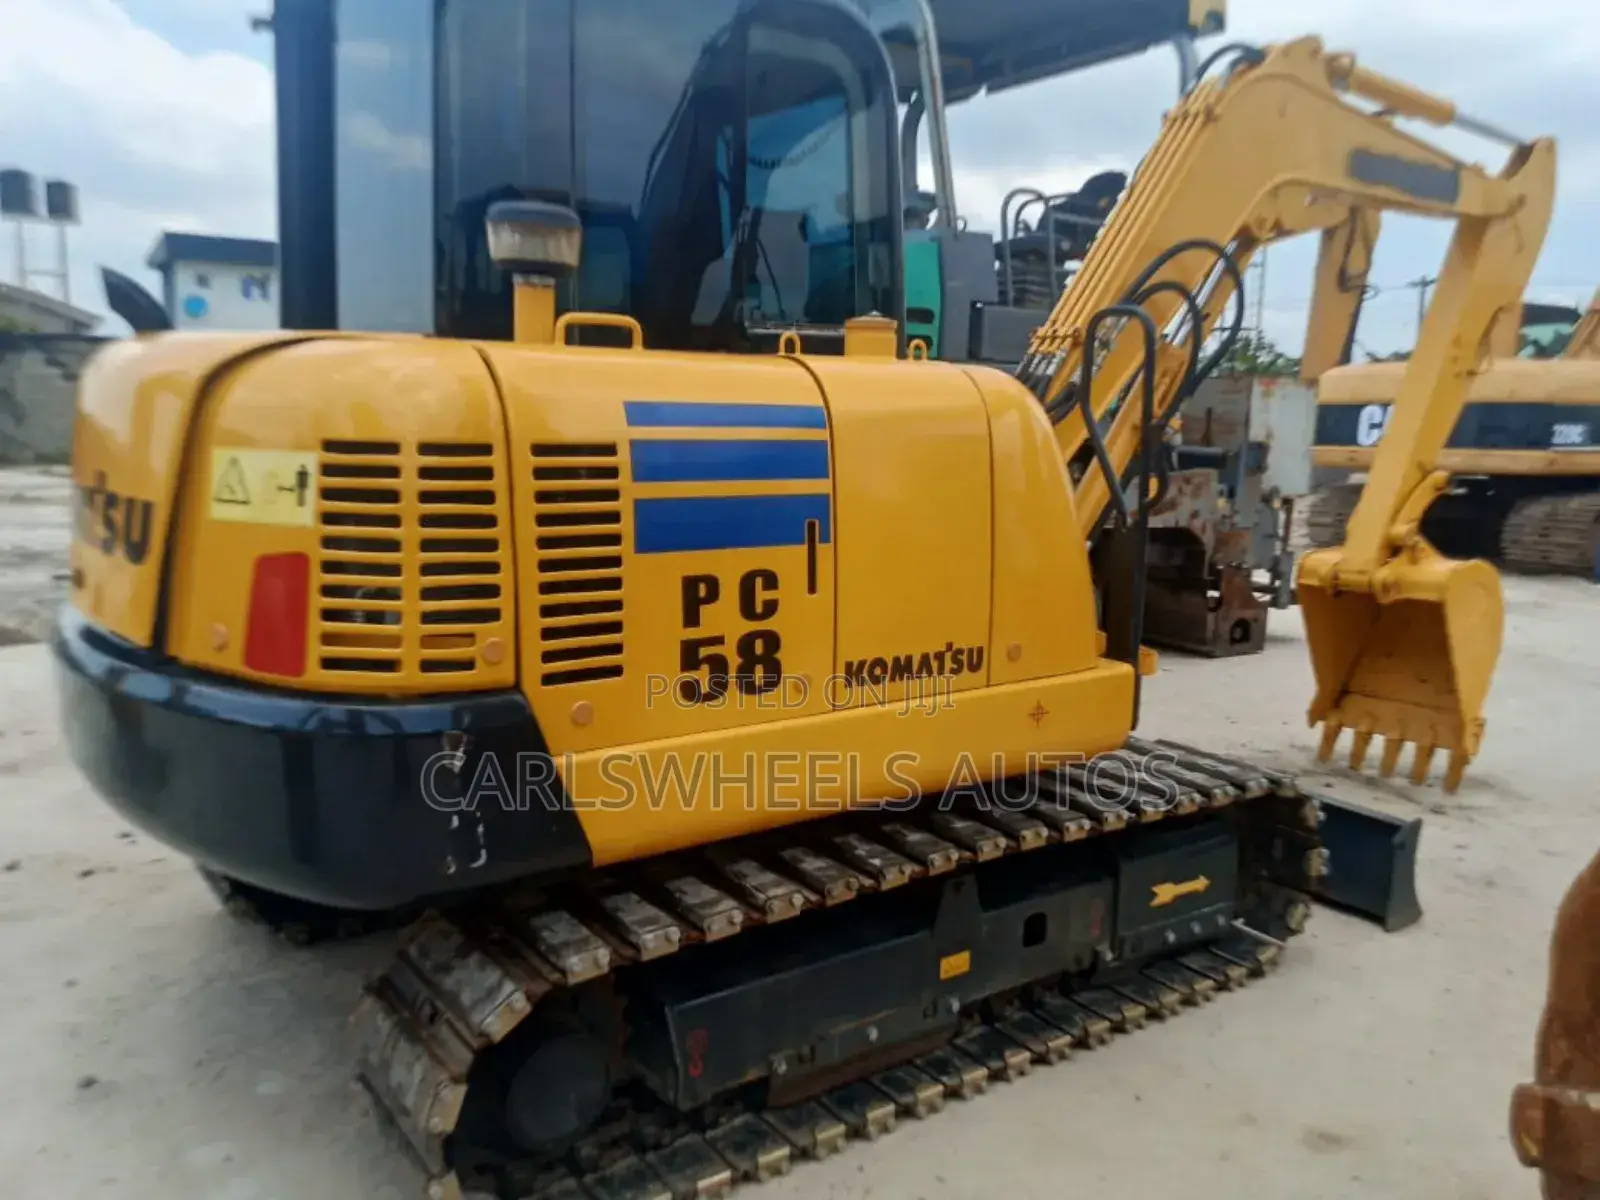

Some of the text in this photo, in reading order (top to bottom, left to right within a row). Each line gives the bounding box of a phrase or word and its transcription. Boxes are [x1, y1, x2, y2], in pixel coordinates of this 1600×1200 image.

[1356, 405, 1395, 446] C
[680, 629, 782, 703] 58
[844, 642, 984, 689] KOMATSU
